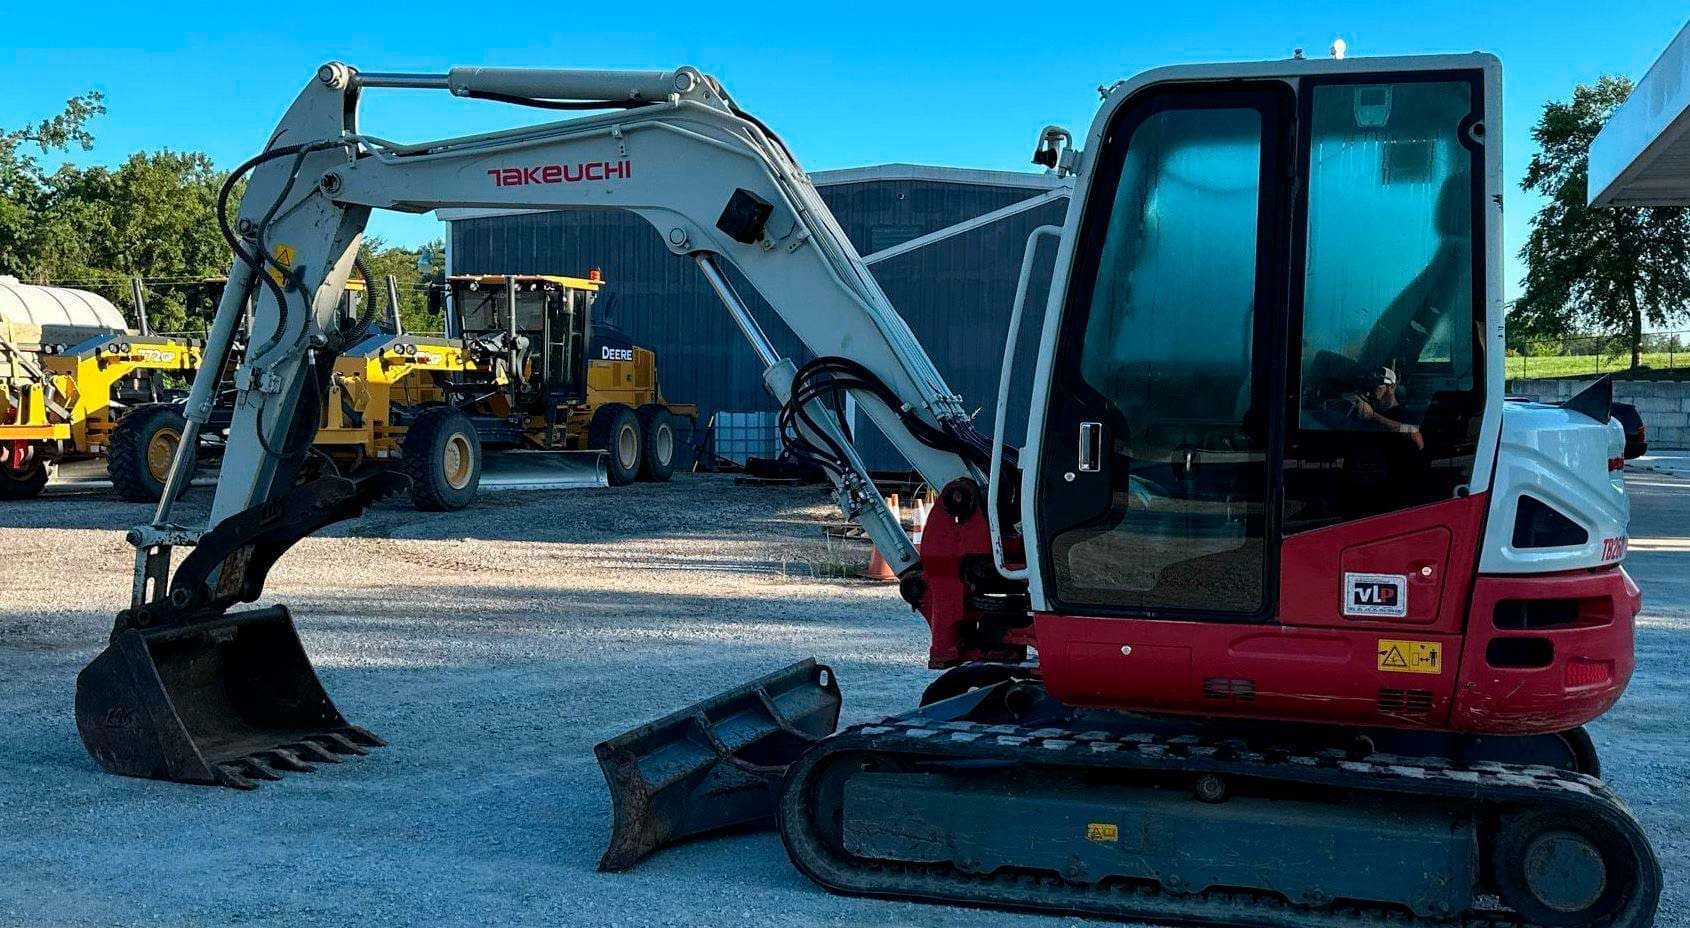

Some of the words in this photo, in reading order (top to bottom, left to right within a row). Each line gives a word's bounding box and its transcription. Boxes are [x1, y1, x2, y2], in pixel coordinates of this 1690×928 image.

[487, 160, 631, 187] TAKEUCHI
[602, 346, 633, 360] DEERE
[1354, 585, 1394, 603] VLP
